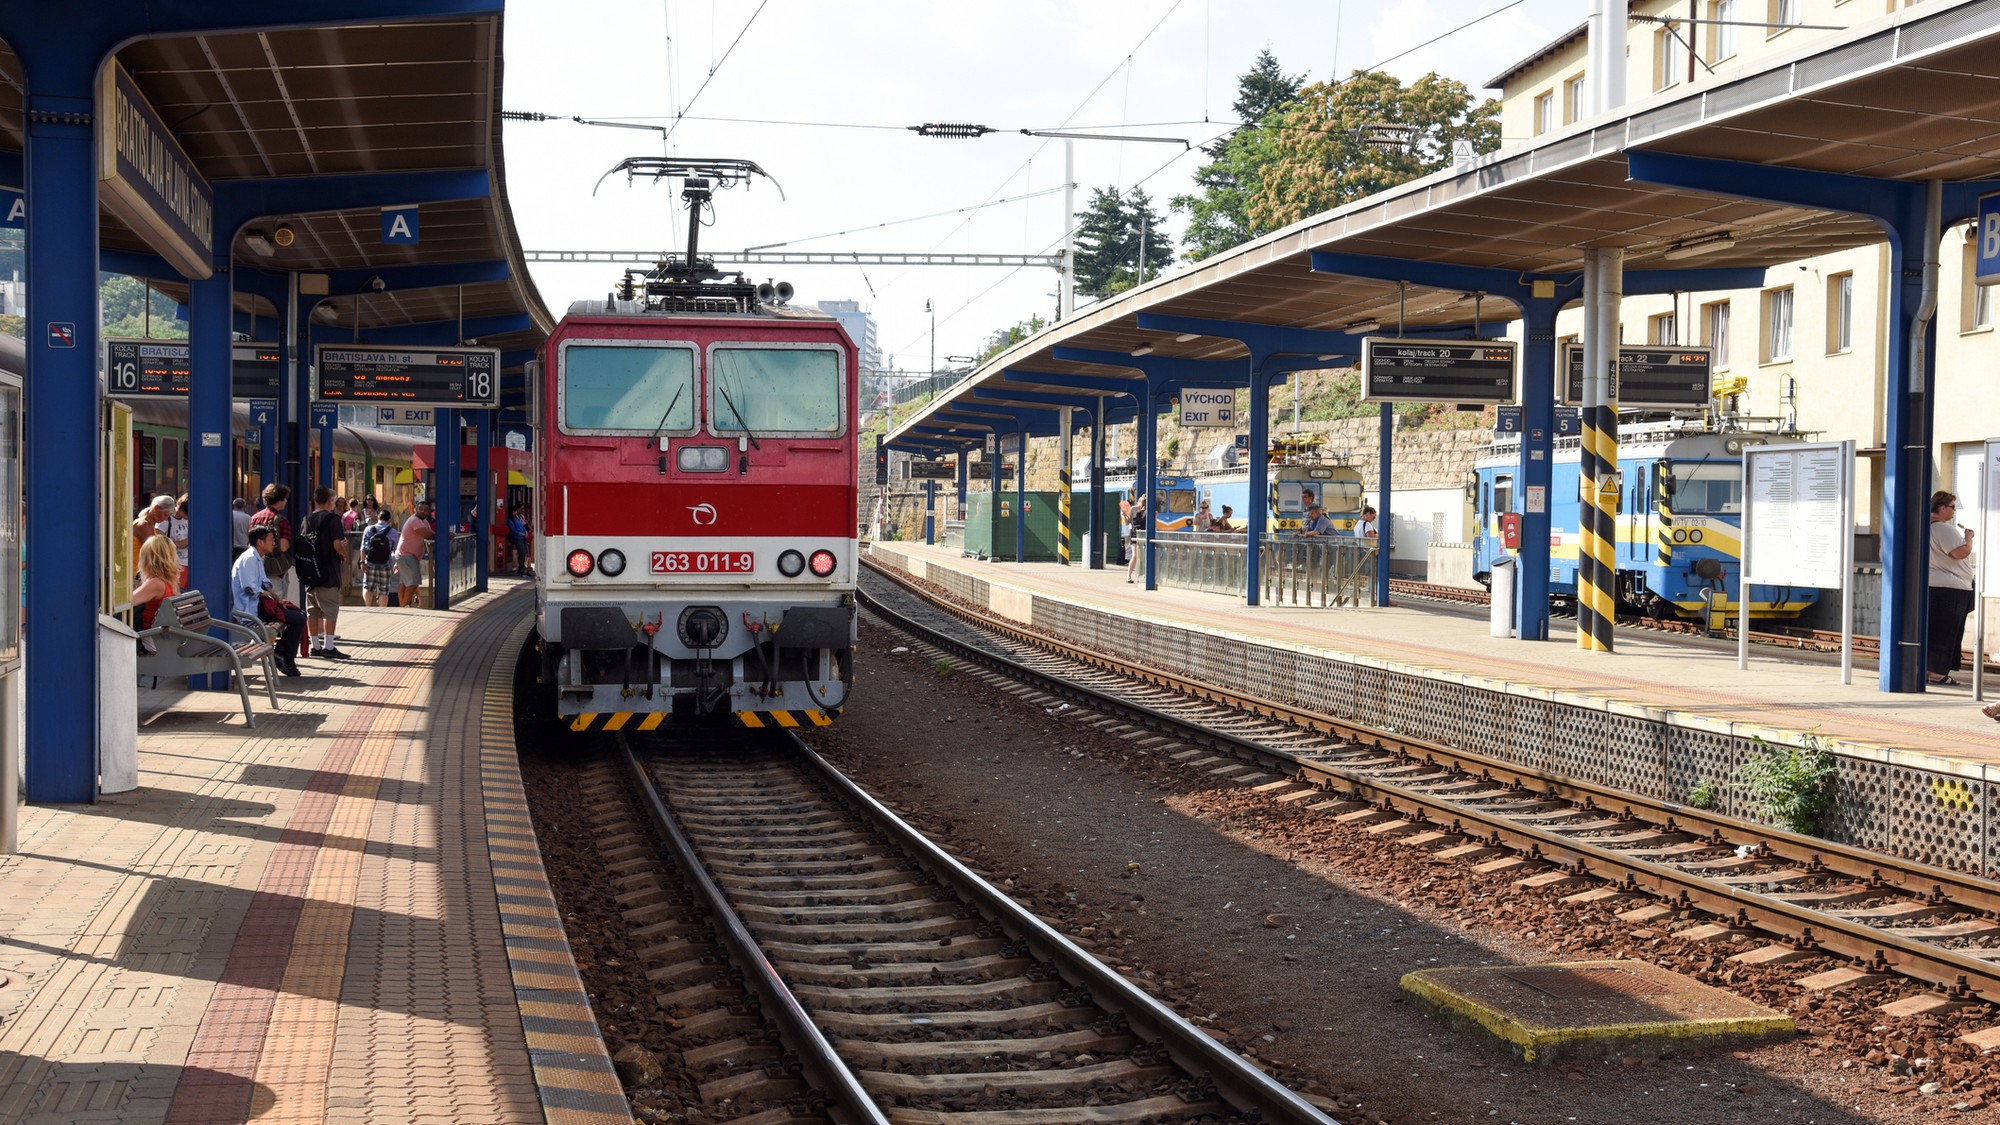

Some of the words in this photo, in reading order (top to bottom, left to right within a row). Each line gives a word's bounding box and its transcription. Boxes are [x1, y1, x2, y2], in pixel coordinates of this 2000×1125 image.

[116, 86, 165, 199] BRATISLAVA
[165, 149, 190, 228] HLAVNÁ
[6, 198, 25, 221] A
[389, 214, 412, 238] A
[325, 352, 386, 362] BRATISLAVA
[402, 355, 413, 363] st.
[1439, 349, 1451, 358] 20
[1636, 354, 1648, 363] 22
[113, 362, 136, 388] 16
[469, 372, 490, 398] 18
[1185, 391, 1232, 404] VÝCHOD
[257, 412, 267, 424] 4
[318, 414, 328, 427] 4
[405, 410, 431, 420] EXIT
[1185, 412, 1209, 422] EXIT
[1504, 418, 1513, 430] 5
[1560, 419, 1569, 432] 5
[653, 553, 690, 571] 263
[696, 553, 752, 571] 011-9
